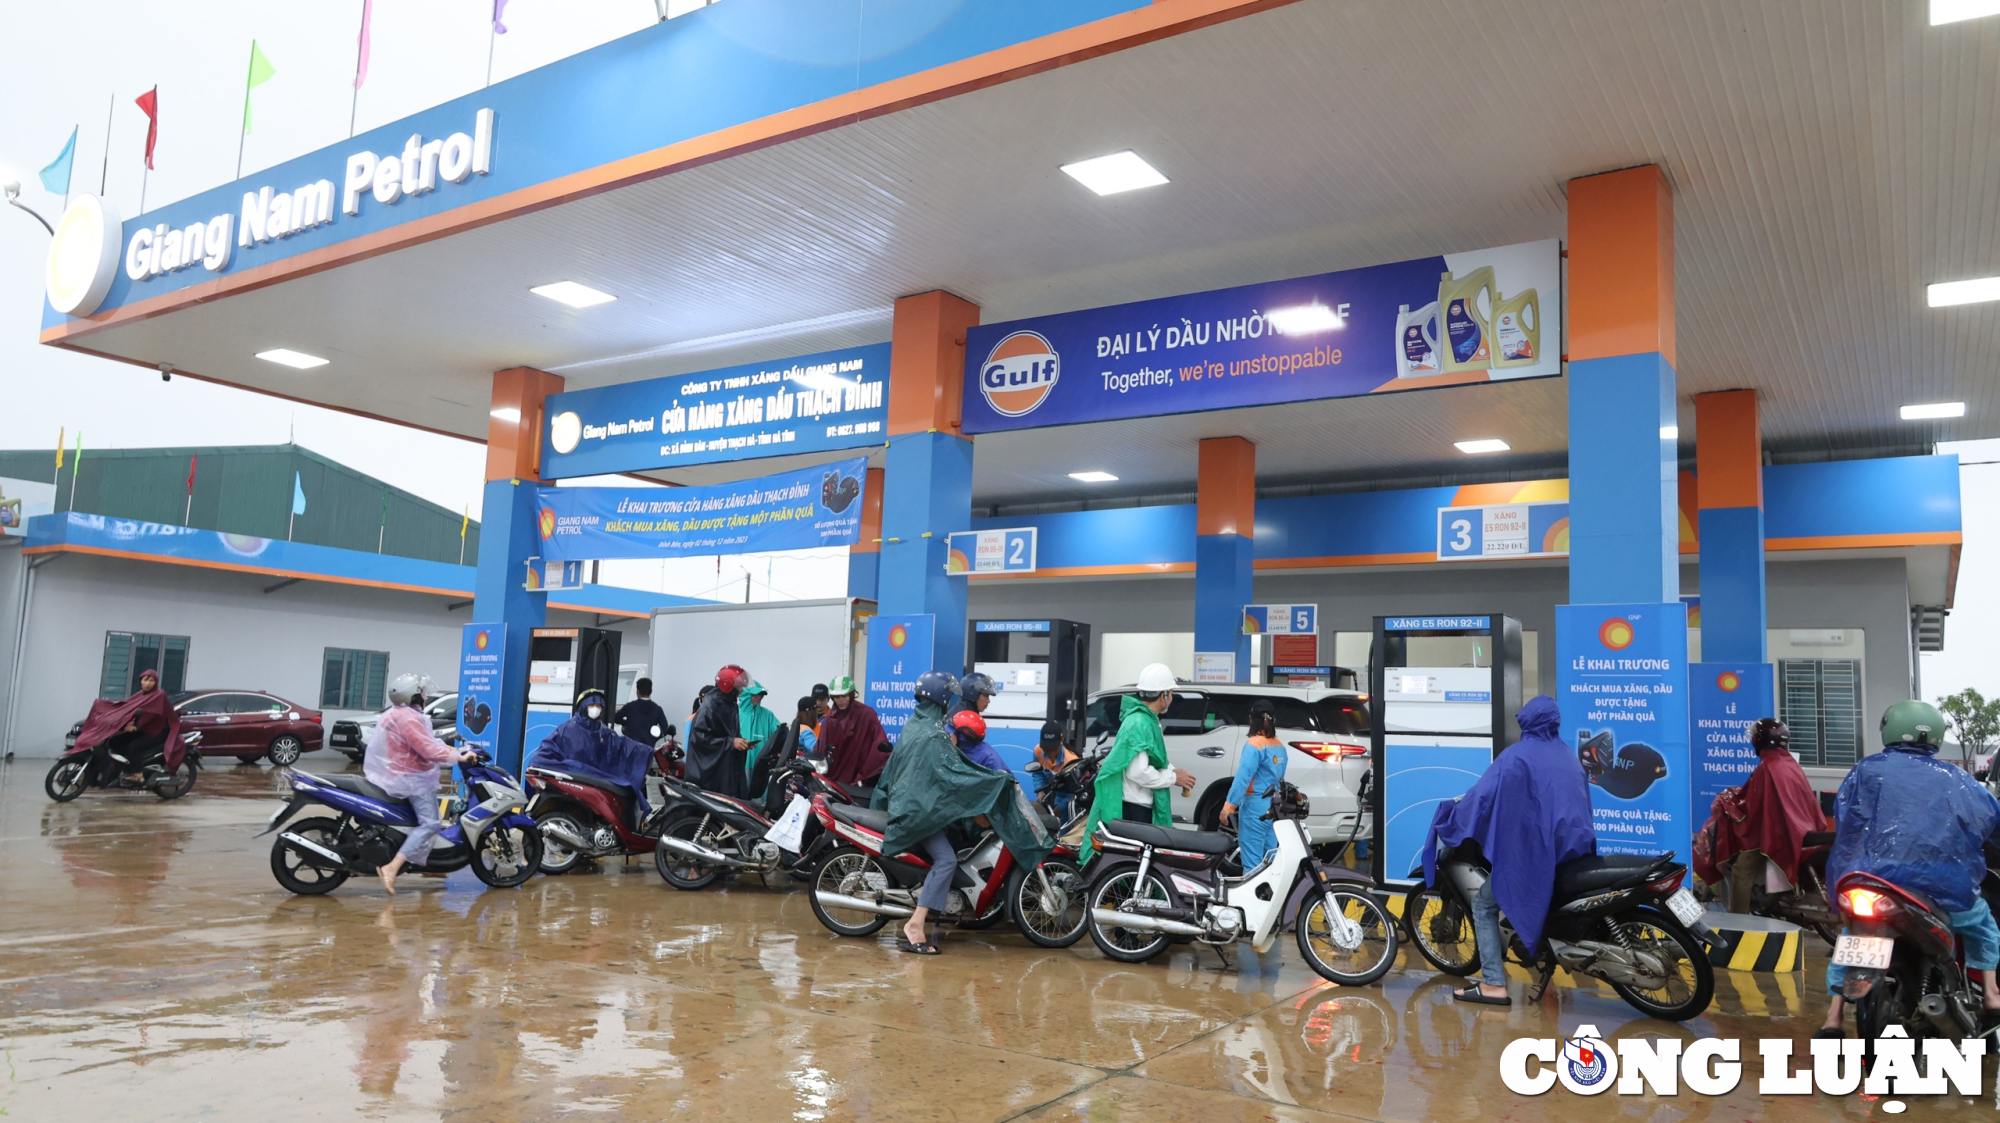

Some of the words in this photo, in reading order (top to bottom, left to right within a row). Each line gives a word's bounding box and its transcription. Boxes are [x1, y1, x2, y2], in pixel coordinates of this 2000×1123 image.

[125, 213, 235, 282] Giang
[239, 178, 335, 249] Nam
[342, 107, 495, 216] Petrol
[1097, 333, 1130, 360] ĐẠI
[1136, 324, 1162, 354] LÝ
[1166, 317, 1210, 349] DẦU
[984, 359, 1056, 389] Gulf
[1101, 367, 1174, 394] Together,
[1229, 345, 1343, 377] unstoppable
[681, 381, 708, 396] CÔNG
[710, 379, 723, 392] TY
[724, 375, 750, 390] TNHH
[751, 371, 781, 386] XĂNG
[806, 362, 837, 376] GIANG
[839, 358, 863, 373] NAM
[661, 399, 686, 435] CỬA
[688, 400, 724, 431] HÀNG
[726, 395, 763, 427] XĂNG
[796, 387, 842, 421] THẠCH
[845, 374, 883, 412] ĐỈNH
[583, 424, 607, 440] Giang
[607, 421, 628, 436] Nam
[628, 416, 655, 434] Petrol
[617, 497, 629, 513] LỄ
[627, 501, 648, 514] KHAI
[649, 500, 683, 514] TRƯƠNG
[683, 496, 701, 513] CỬA
[701, 496, 725, 512] HÀNG
[724, 493, 746, 510] XĂNG
[746, 489, 764, 506] DẦU
[764, 487, 788, 506] THẠCH
[557, 516, 580, 526] GIANG
[581, 516, 599, 525] NAM
[605, 517, 633, 532] KHÁCH
[633, 521, 654, 532] MUA
[654, 518, 681, 533] XĂNG,
[682, 517, 700, 532] DẦU
[701, 517, 726, 532] ĐƯỢC
[726, 513, 749, 531] TẶNG
[749, 510, 769, 528] MỘT
[769, 507, 793, 522] PHẦN
[794, 502, 815, 520] QUÀ
[1494, 511, 1517, 520] XĂNG
[556, 526, 582, 535] PETROL
[1484, 523, 1494, 533] E5
[1494, 522, 1509, 532] RON
[1510, 521, 1526, 531] 92-II
[723, 537, 735, 545] năm
[734, 535, 749, 544] 2023
[1450, 519, 1472, 552] 3
[977, 546, 989, 554] RON
[1009, 537, 1025, 565] 2
[1486, 543, 1510, 551] 22.220
[569, 561, 576, 583] 1
[984, 622, 1005, 630] XĂNG
[1296, 611, 1309, 630] 5
[1393, 619, 1420, 629] XĂNG
[1422, 620, 1435, 628] E5
[1437, 619, 1458, 628] RON
[1460, 619, 1482, 628] 92-II
[893, 661, 902, 675] LỄ
[1573, 655, 1585, 670] LỄ
[1587, 659, 1615, 670] KHAI
[1618, 659, 1670, 670] TRƯƠNG
[871, 681, 889, 692] KHAI
[1571, 683, 1600, 693] KHÁCH
[1601, 685, 1622, 693] MUA
[1624, 683, 1652, 694] XĂNG,
[1653, 682, 1673, 693] DẦU
[876, 695, 893, 709] CỬA
[893, 697, 916, 709] HÀNG
[1595, 698, 1621, 709] ĐƯỢC
[1622, 696, 1647, 709] TẶNG
[1726, 702, 1737, 714] LỄ
[1588, 710, 1608, 722] MỘT
[1609, 710, 1634, 721] PHẦN
[1635, 711, 1656, 722] QUÀ
[1698, 719, 1721, 728] KHAI
[1706, 731, 1727, 743] CỬA
[1729, 732, 1751, 744] HÀN
[1707, 746, 1735, 758] XĂNG
[1703, 762, 1735, 774] THẠCH
[1593, 808, 1621, 820] ƯỢNG
[1622, 809, 1642, 820] QUÀ
[1643, 810, 1672, 822] TẶNG:
[1608, 821, 1634, 833] PHẦN
[1635, 824, 1655, 835] QUÀ
[1599, 845, 1613, 853] ngày
[1621, 846, 1638, 855] tháng
[1844, 937, 1884, 952] 38-P1
[1837, 950, 1885, 966] 355.21
